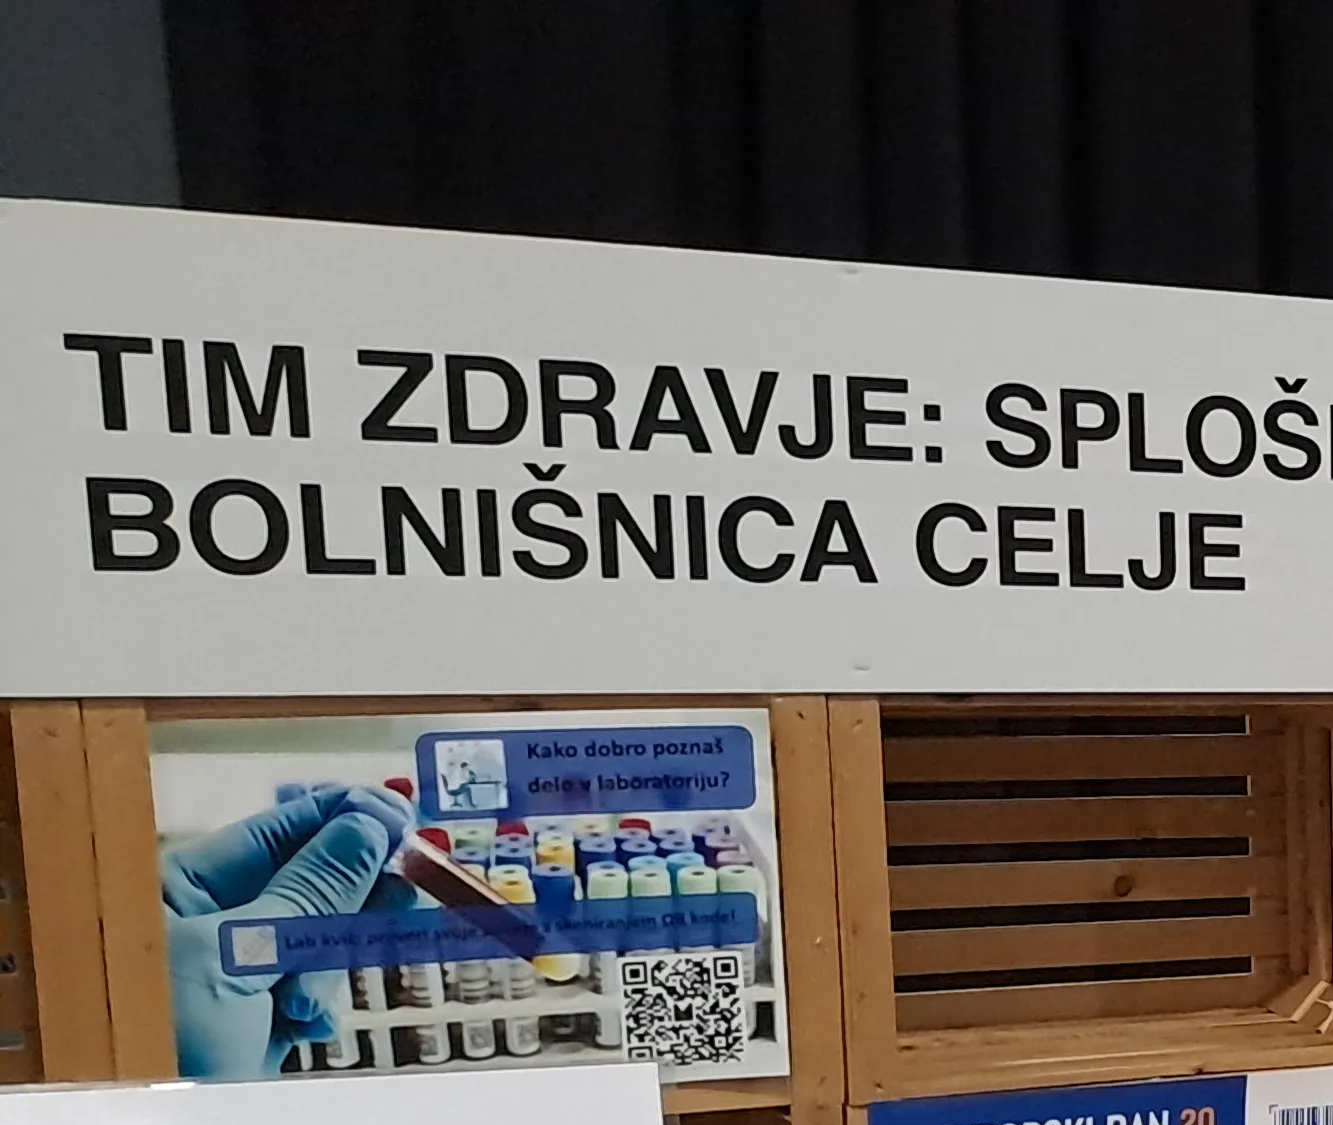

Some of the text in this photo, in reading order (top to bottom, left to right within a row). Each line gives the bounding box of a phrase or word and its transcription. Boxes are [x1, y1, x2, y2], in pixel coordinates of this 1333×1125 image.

[62, 332, 310, 439] TIM
[356, 347, 942, 464] ZDRAVJE:
[85, 462, 1247, 592] BOLNIŠNICA CELJE
[526, 736, 724, 760] Kako dobro poznaš
[528, 776, 573, 794] delo
[598, 771, 730, 797] laboratoriju?
